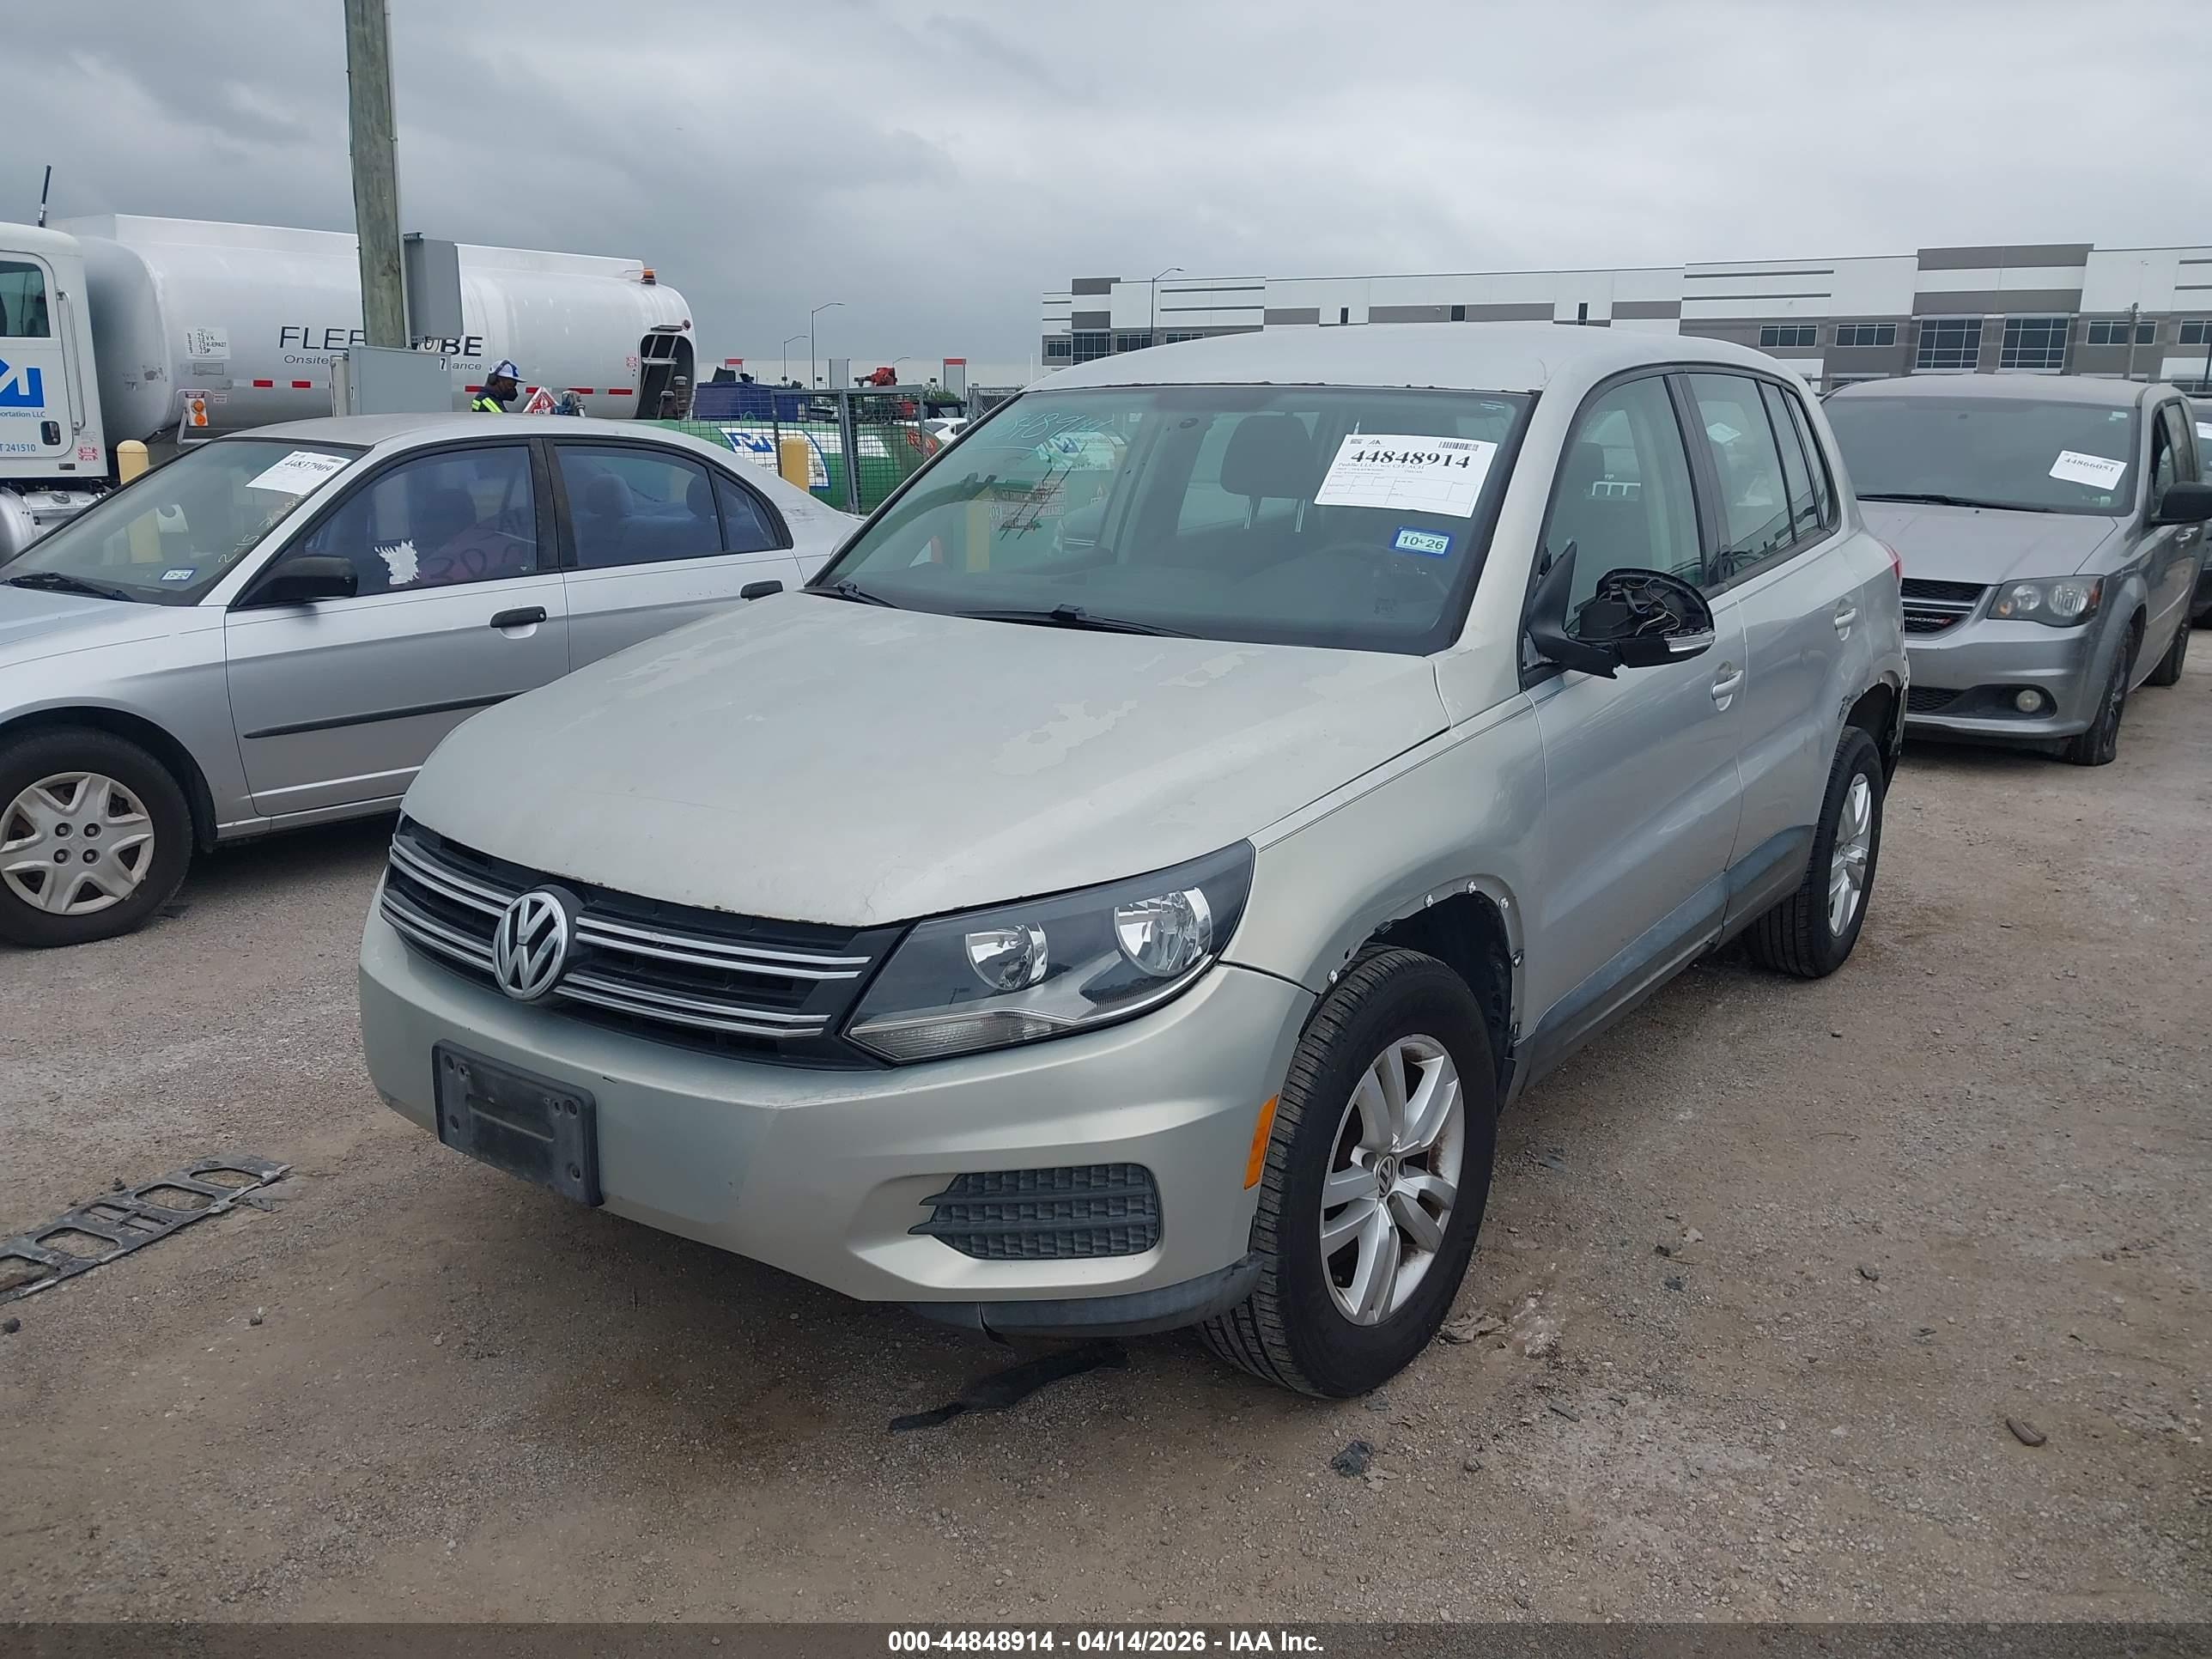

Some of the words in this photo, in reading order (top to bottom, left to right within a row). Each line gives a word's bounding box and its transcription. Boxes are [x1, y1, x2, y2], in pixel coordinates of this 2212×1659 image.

[283, 355, 330, 365] Onsite
[440, 357, 447, 370] 7
[451, 362, 482, 371] ance
[6, 443, 36, 453] 241510
[1351, 450, 1471, 469] 44848914
